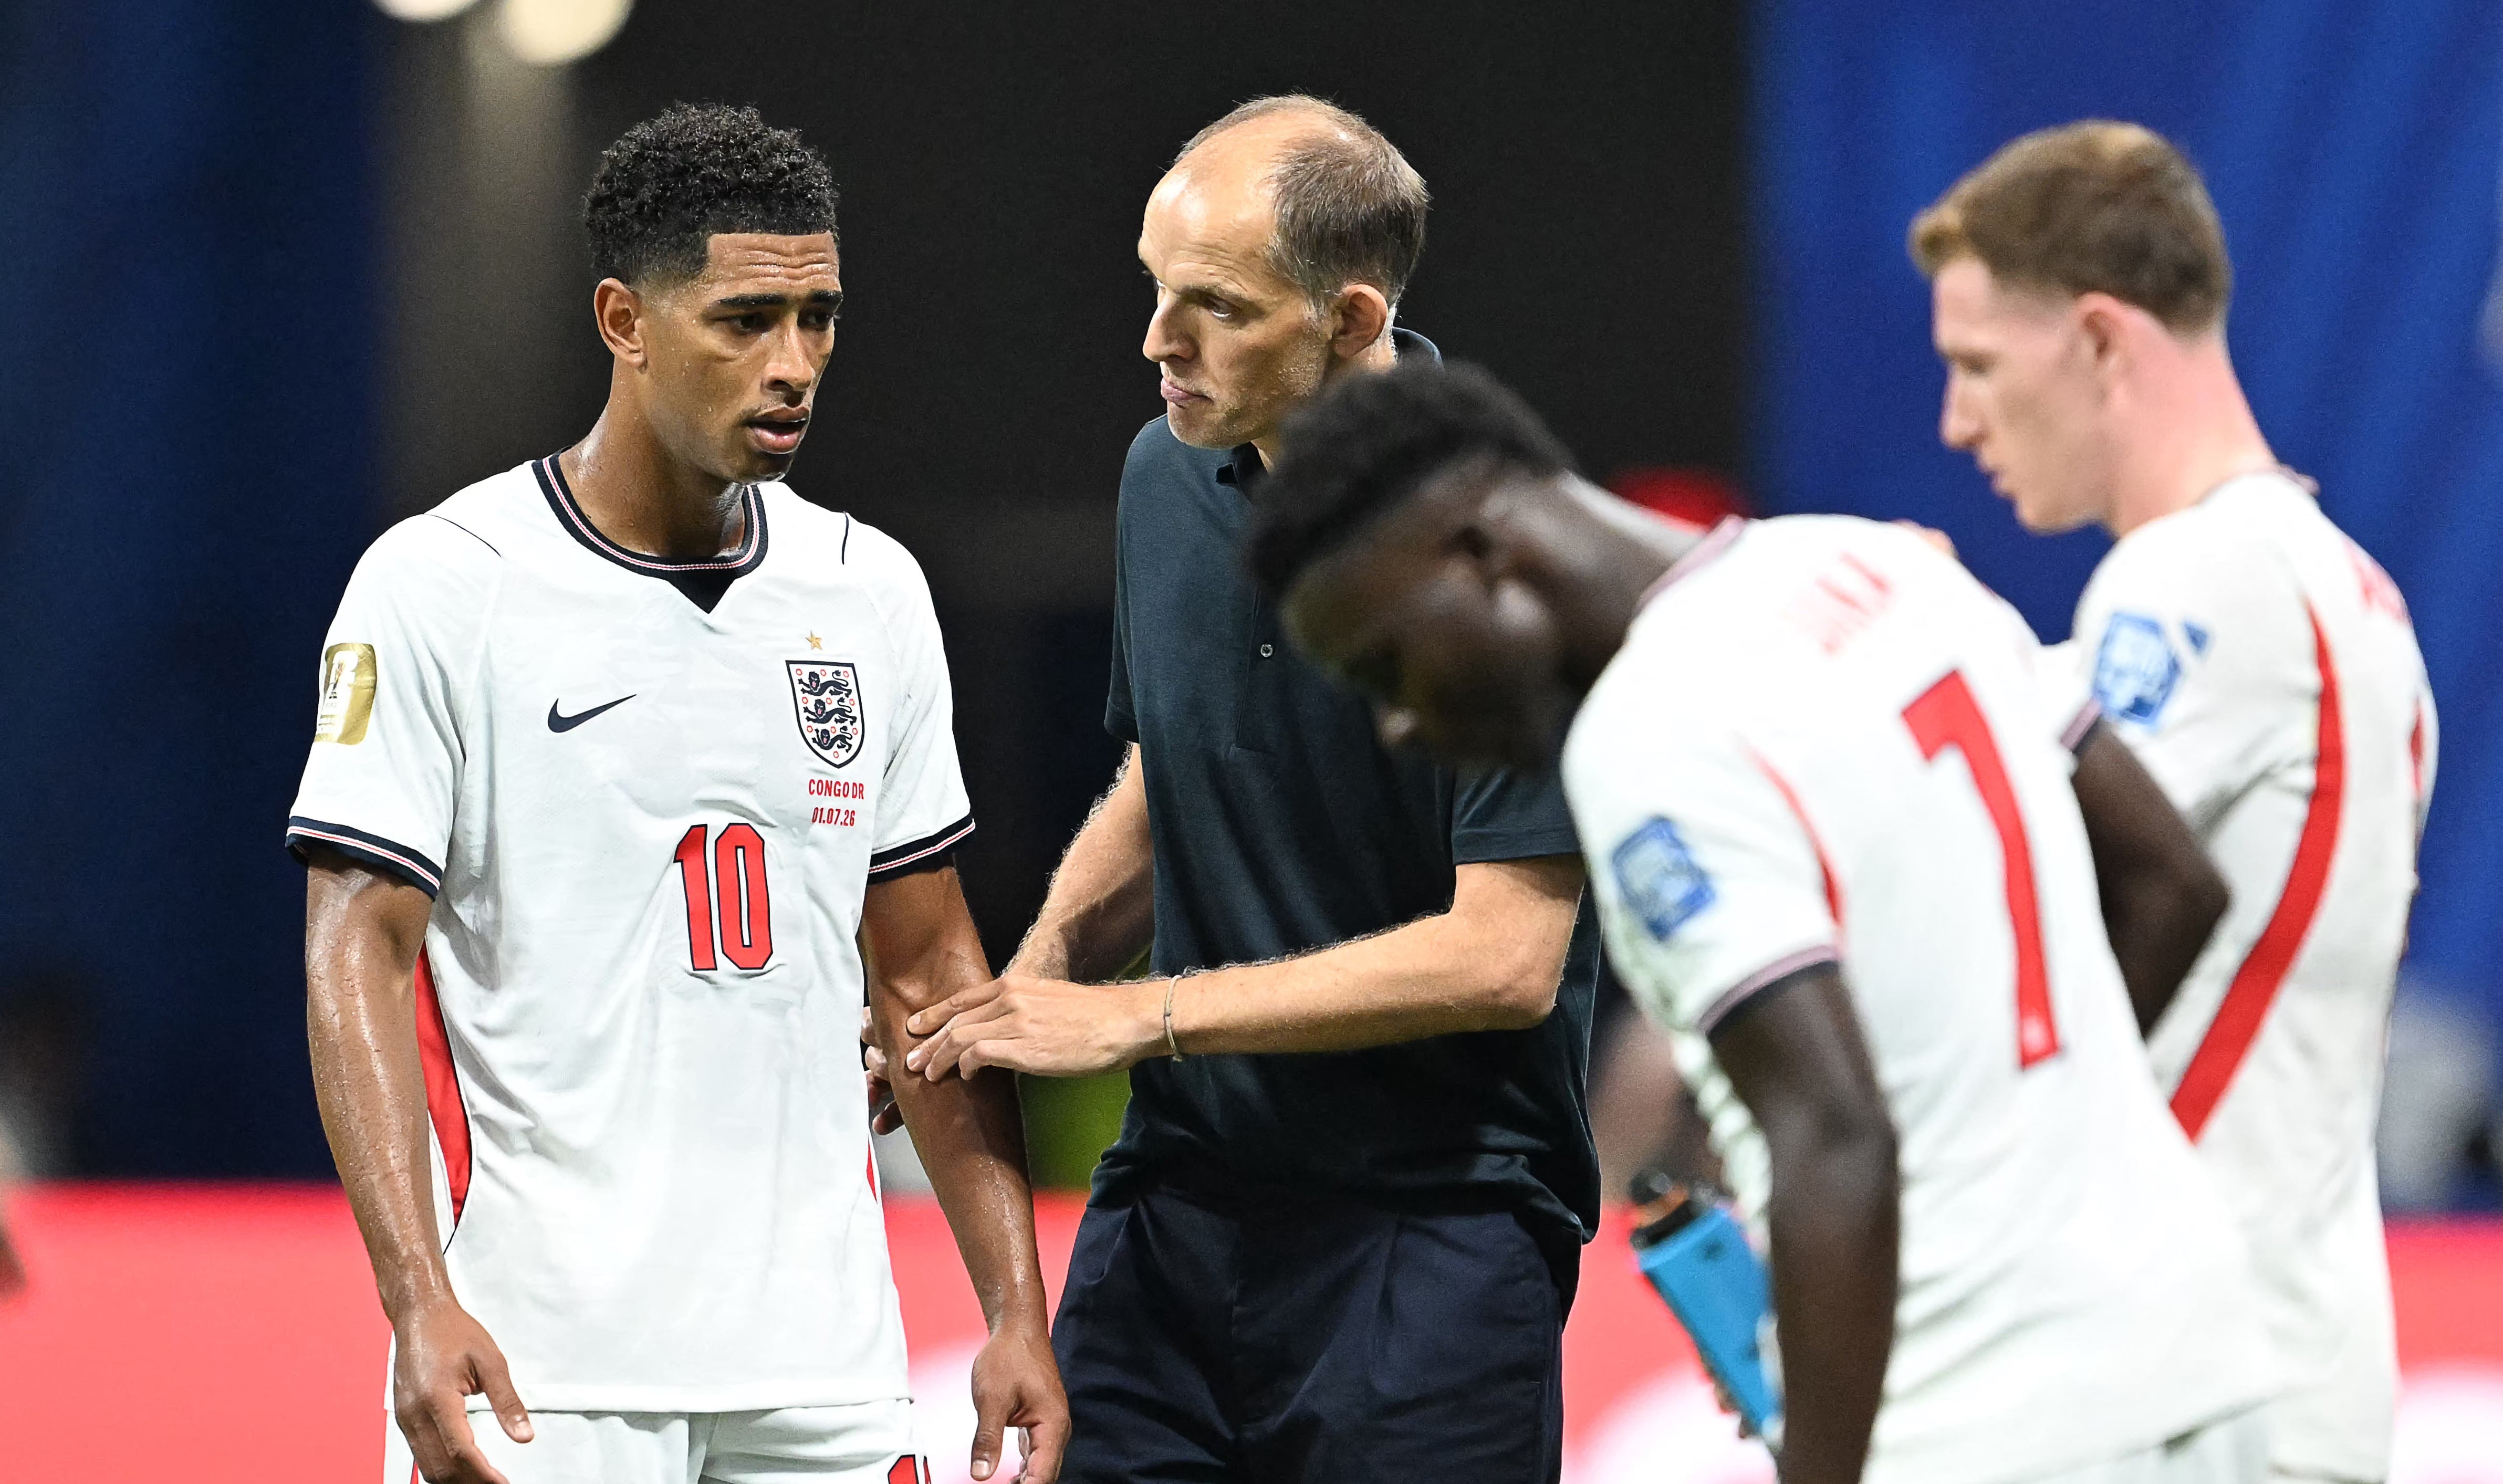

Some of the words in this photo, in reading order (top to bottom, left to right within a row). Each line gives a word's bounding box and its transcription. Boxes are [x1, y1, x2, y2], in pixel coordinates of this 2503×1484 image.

[808, 779, 849, 798] CONGO
[851, 782, 864, 800] DR
[811, 807, 856, 827] 01.07.26
[673, 823, 773, 971] 10
